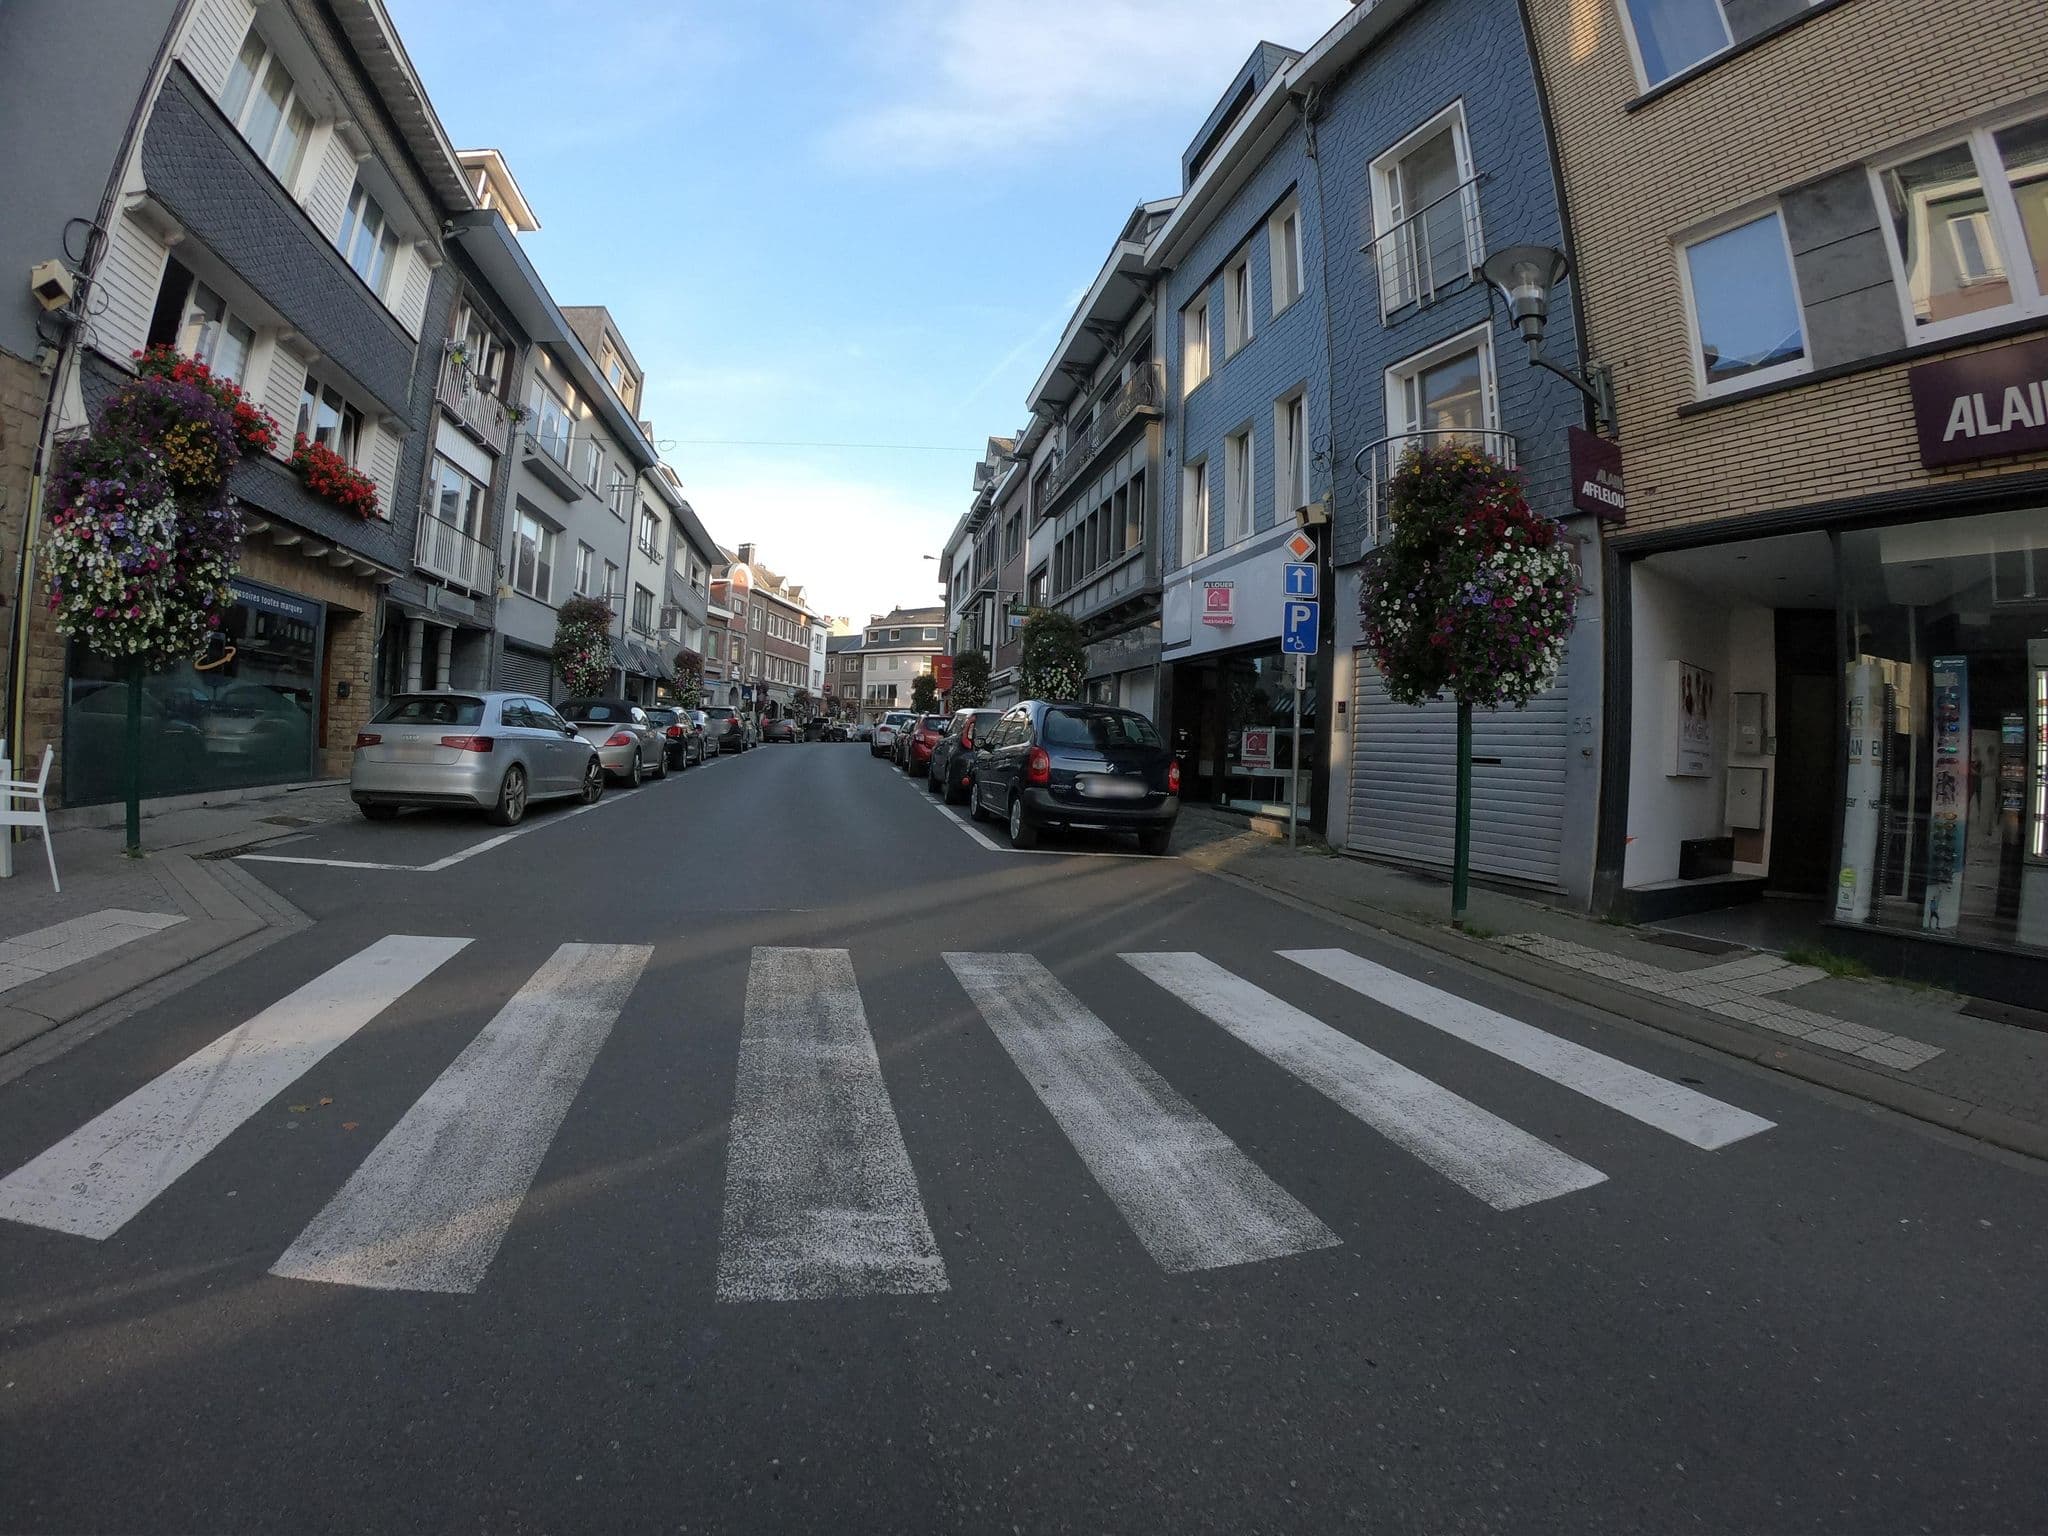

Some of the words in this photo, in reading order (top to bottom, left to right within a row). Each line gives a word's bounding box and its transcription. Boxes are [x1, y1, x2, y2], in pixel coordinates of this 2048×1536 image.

[1942, 379, 2048, 442] ALAI
[1582, 480, 1625, 509] AFFLELOU
[261, 596, 279, 608] toutes
[280, 602, 303, 614] marques
[1291, 604, 1311, 633] P
